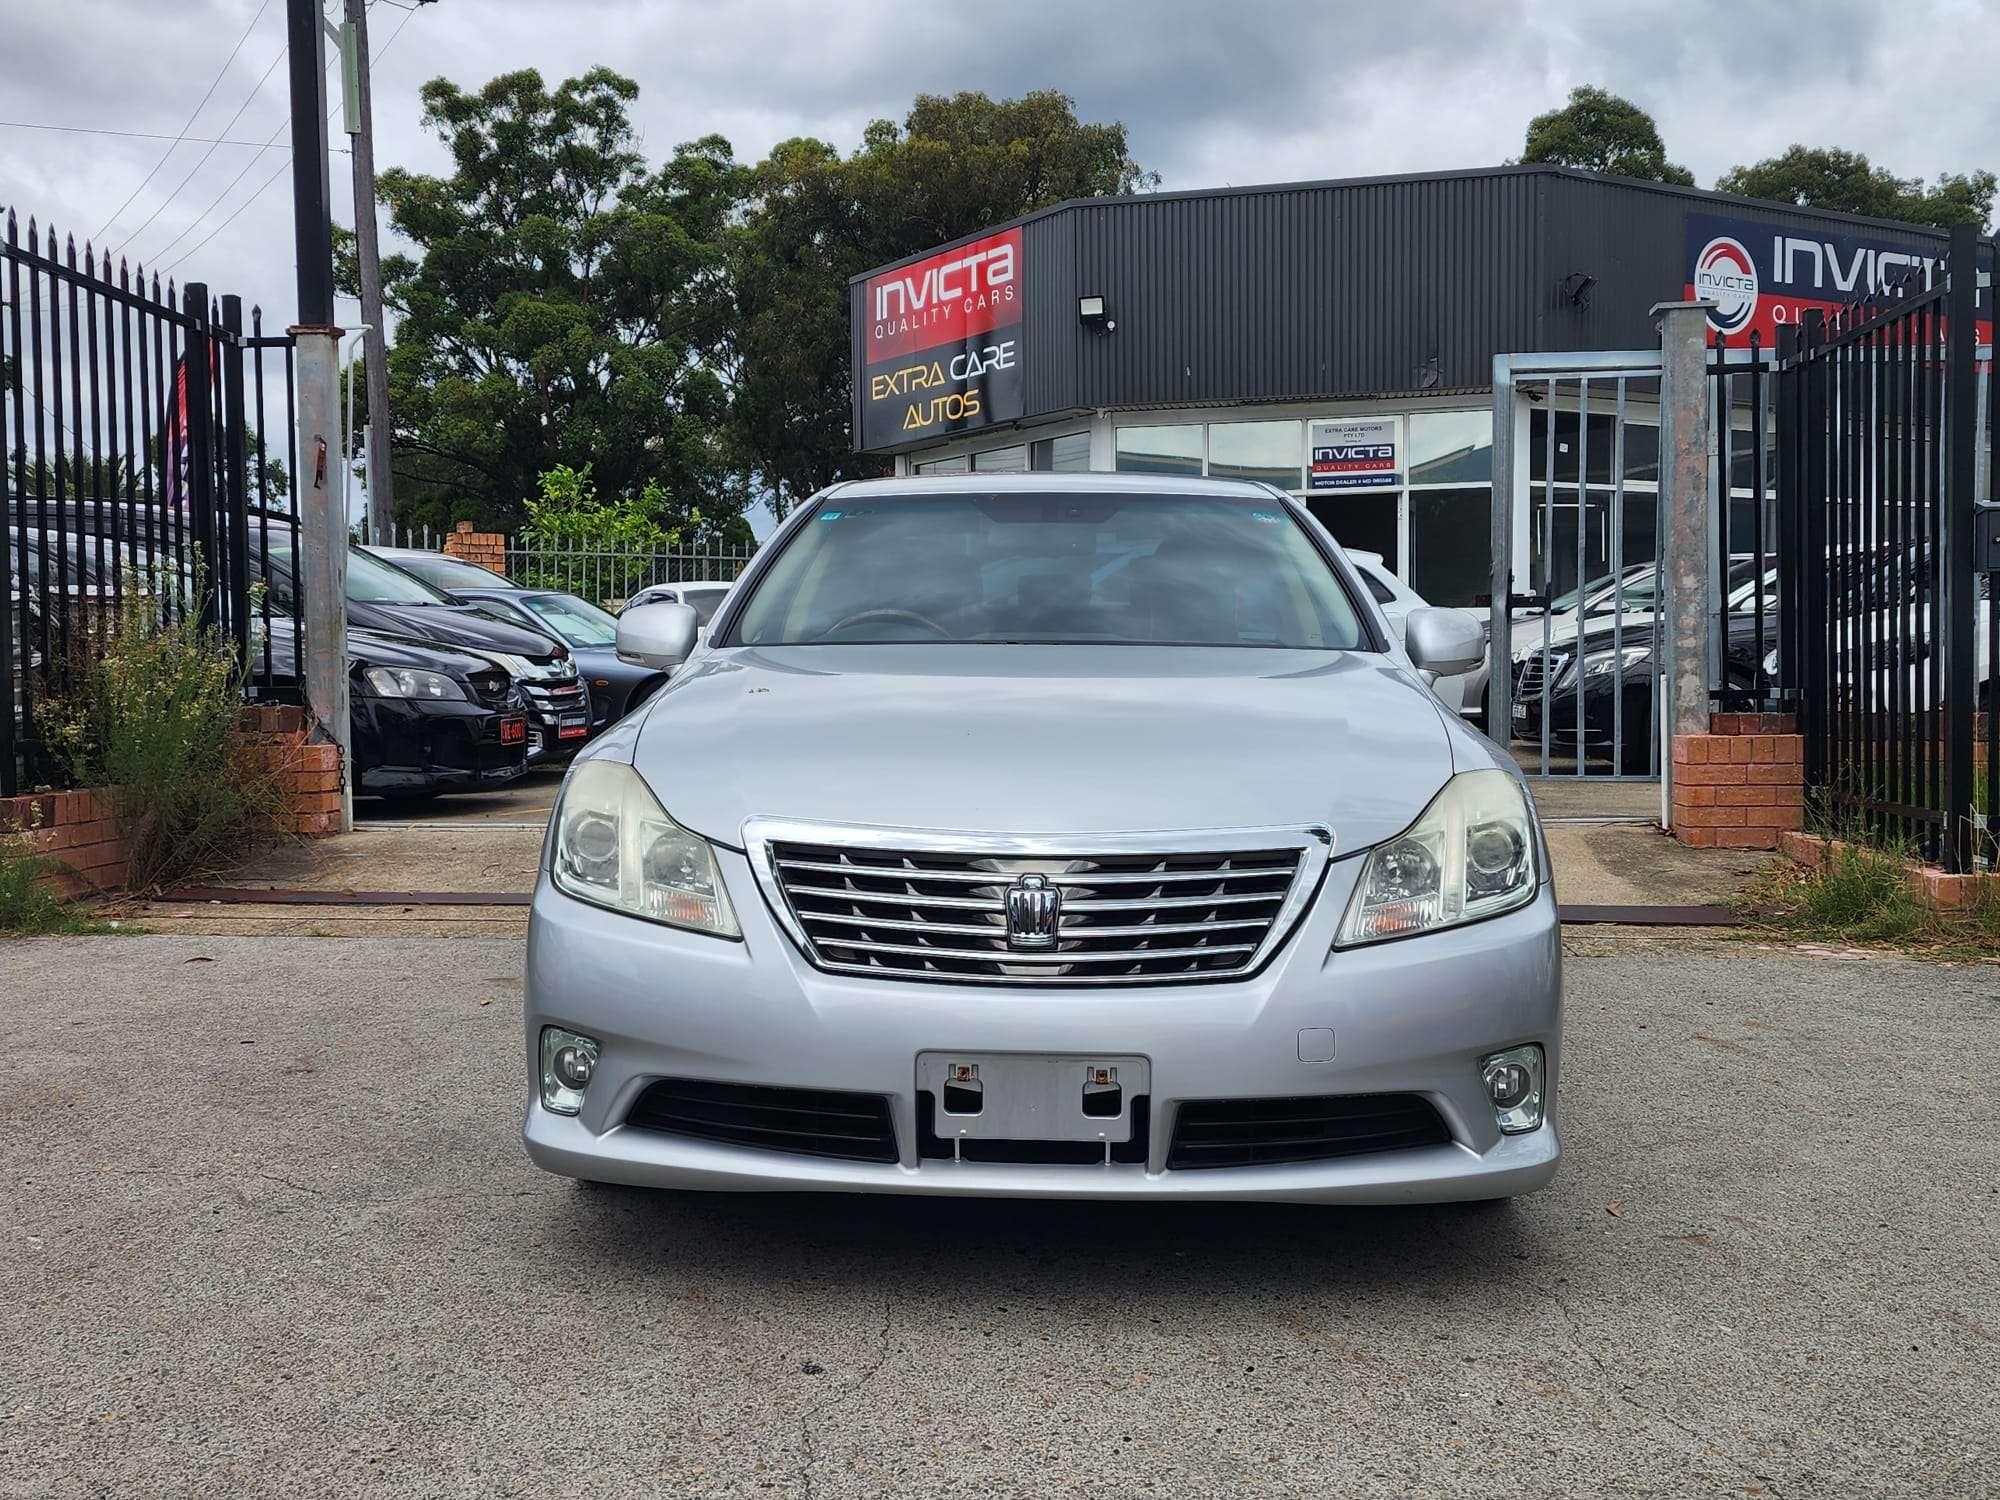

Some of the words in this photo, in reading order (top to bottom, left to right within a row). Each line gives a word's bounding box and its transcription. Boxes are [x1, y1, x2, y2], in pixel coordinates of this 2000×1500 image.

[876, 243, 1014, 321] INVICTA
[1699, 273, 1754, 291] INVICTA
[875, 304, 951, 339] QUALITY
[964, 285, 1014, 313] CARS
[872, 361, 945, 401] EXTRA
[950, 341, 1015, 381] CARE
[903, 389, 981, 430] AUTOS
[1315, 446, 1392, 460] INVICTA
[1316, 463, 1359, 471] QUALITY
